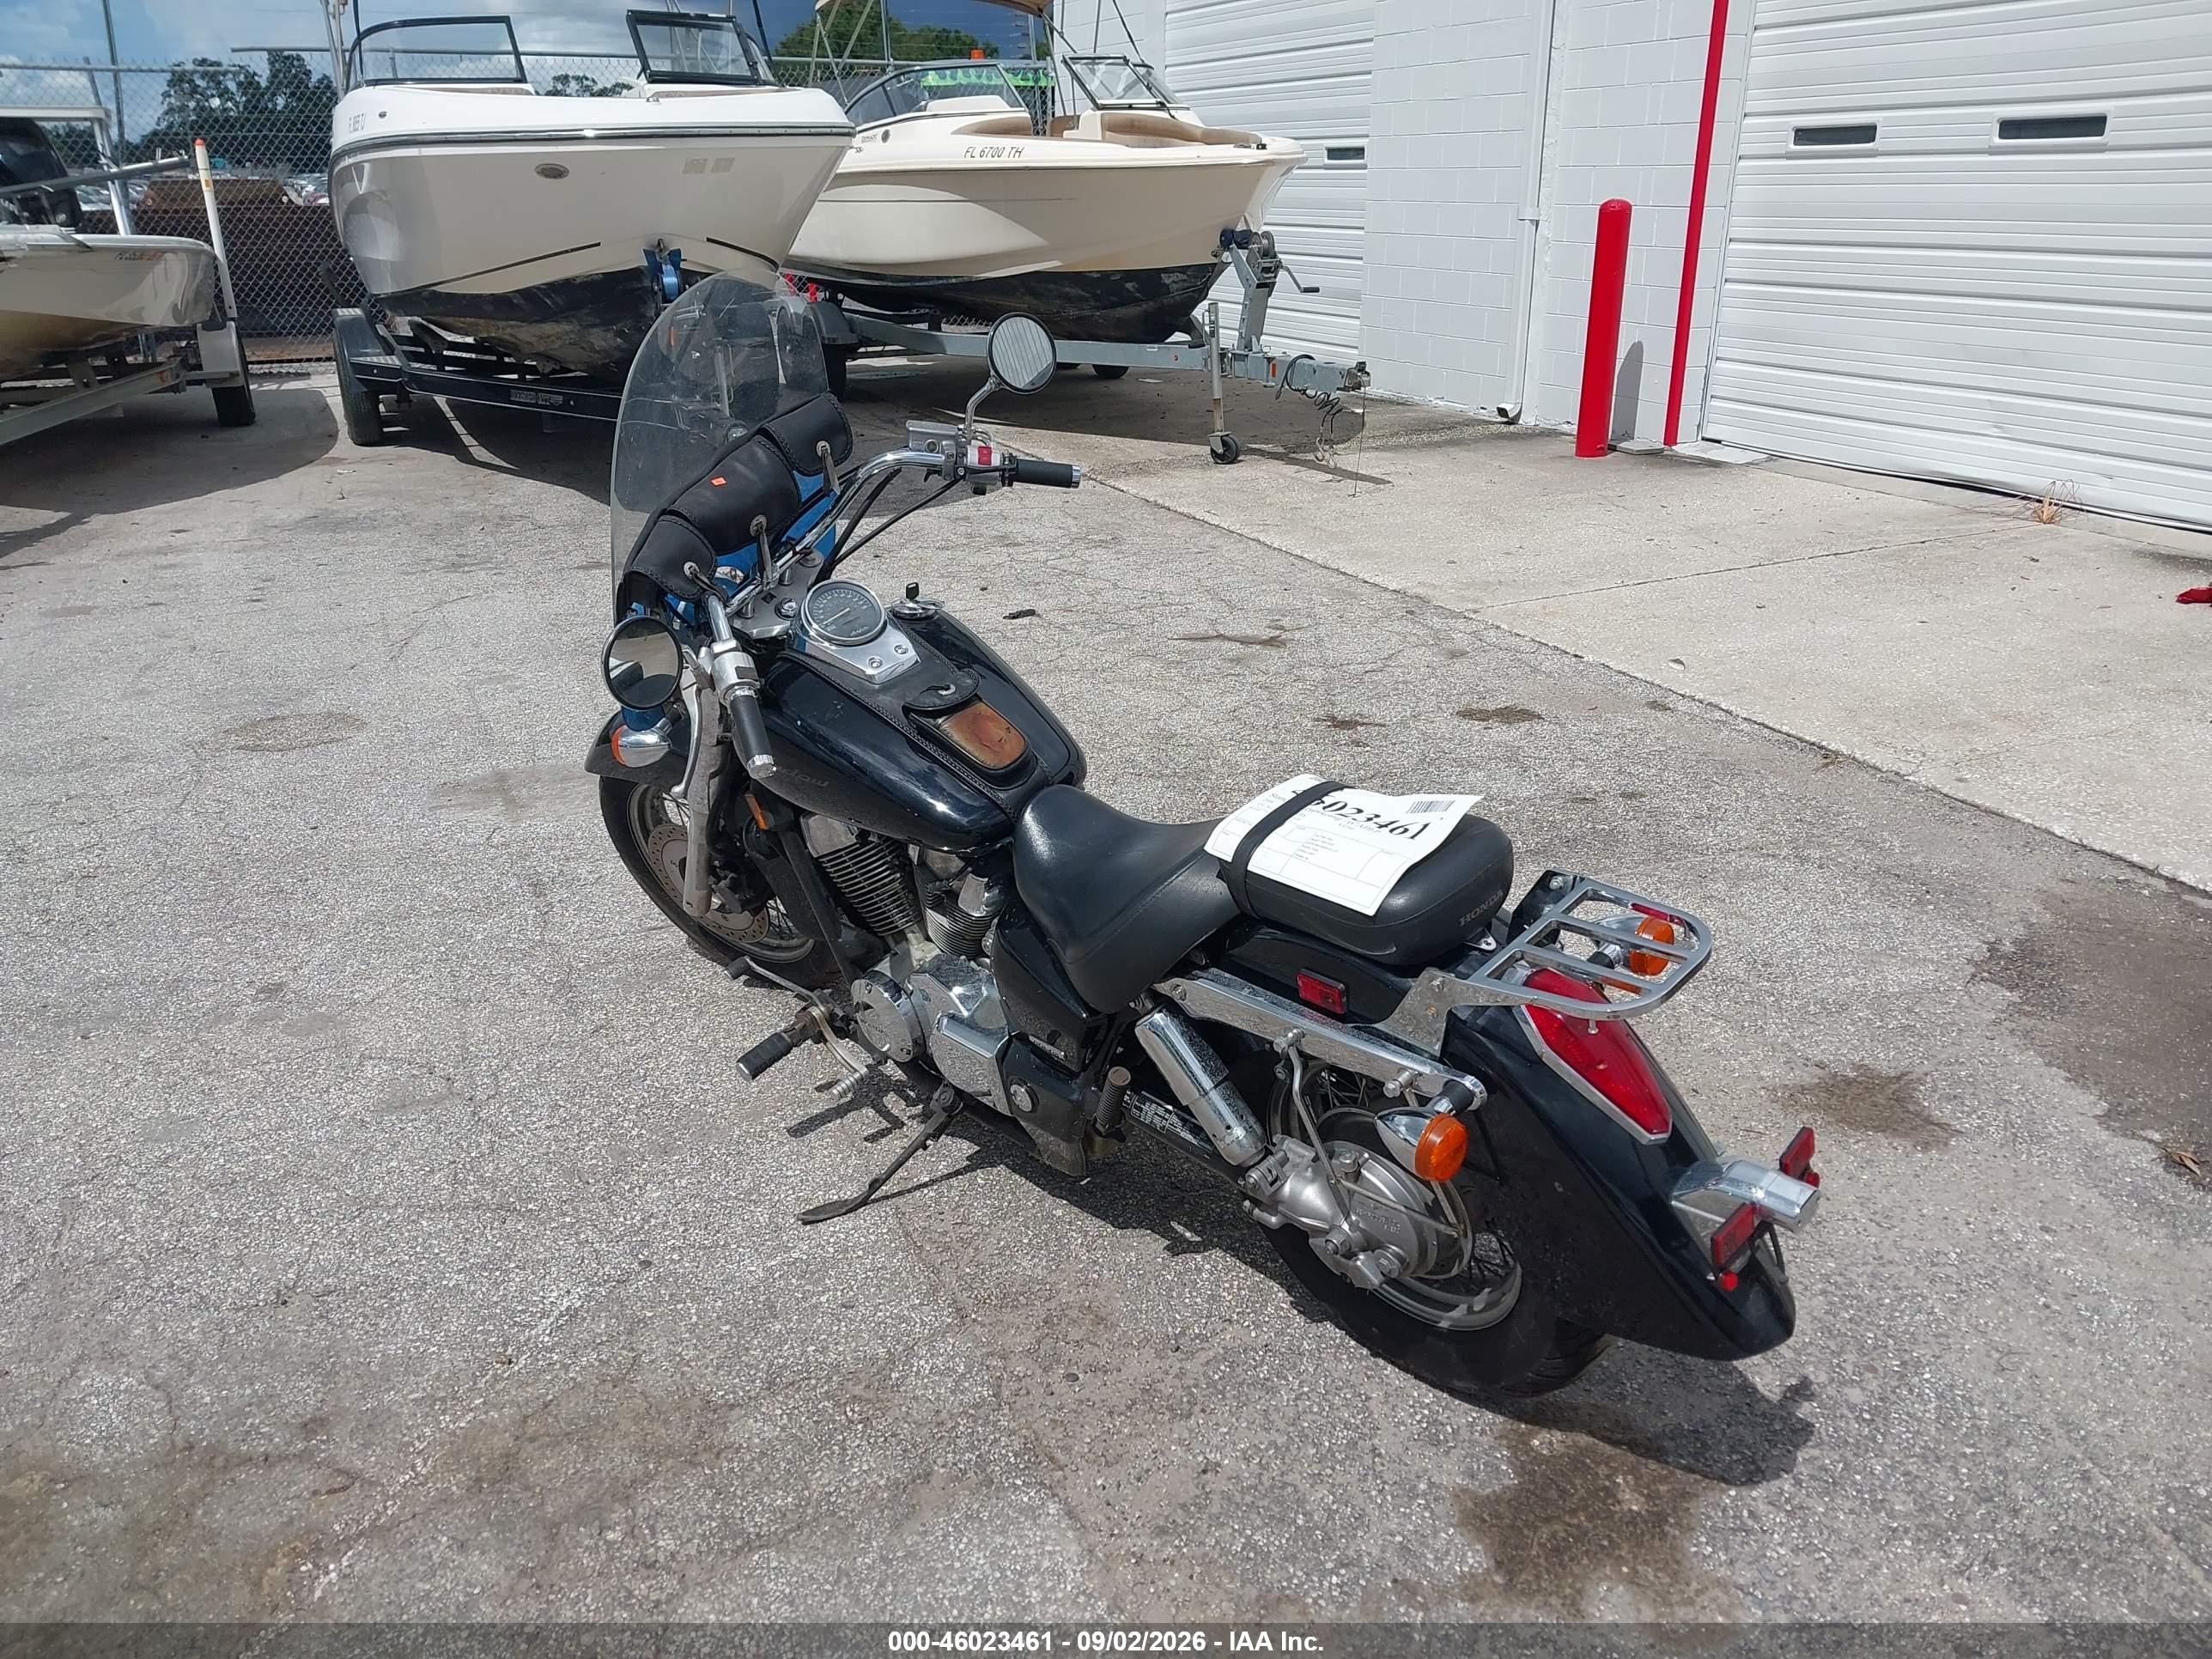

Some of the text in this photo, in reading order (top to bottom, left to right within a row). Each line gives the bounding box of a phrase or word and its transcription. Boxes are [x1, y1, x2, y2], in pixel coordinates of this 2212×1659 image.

[963, 146, 1025, 159] FL 6700 TH
[1291, 789, 1431, 840] 023461
[1459, 890, 1503, 927] HONDA
